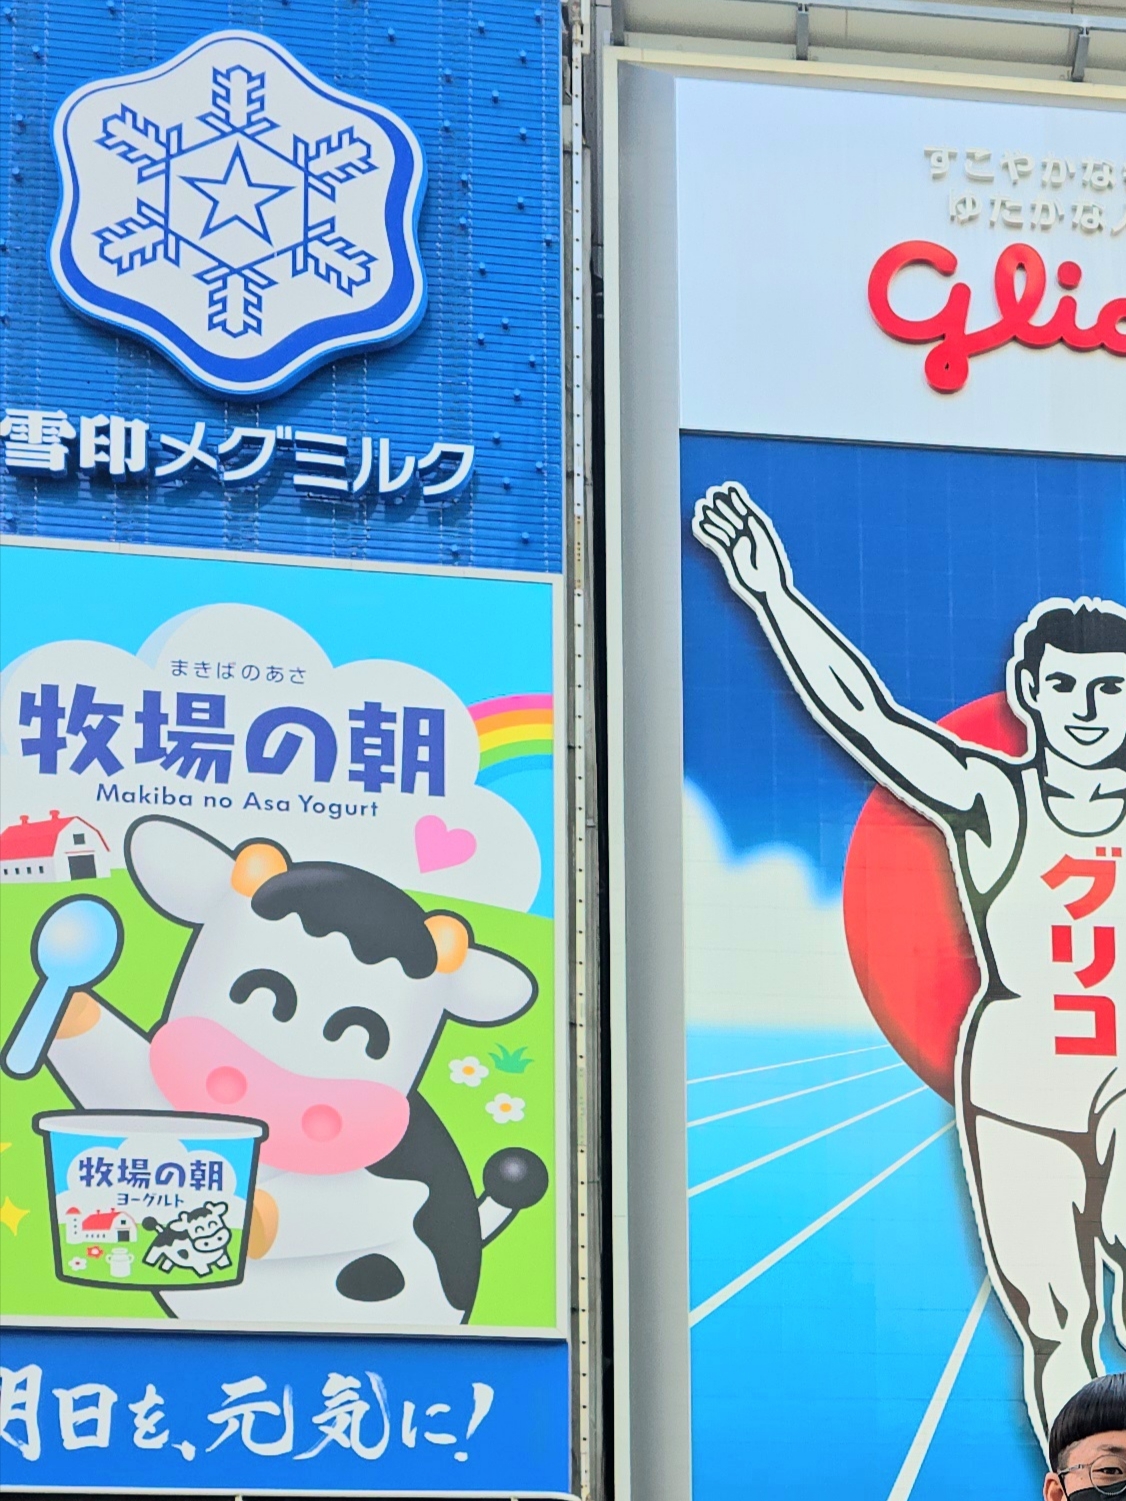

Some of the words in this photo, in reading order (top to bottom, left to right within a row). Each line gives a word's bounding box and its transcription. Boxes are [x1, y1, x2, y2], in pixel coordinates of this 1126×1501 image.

[0, 407, 476, 496] 雪印メグミルク
[170, 658, 307, 685] まきばのあさ
[18, 683, 446, 798] 牧場の朝
[96, 784, 193, 808] Makiba
[203, 794, 233, 809] no
[243, 792, 291, 812] Asa
[298, 794, 379, 820] Yogurt
[1040, 846, 1122, 1057] グリコ
[78, 1156, 224, 1192] 牧場の朝
[116, 1192, 185, 1209] ヨーグルト
